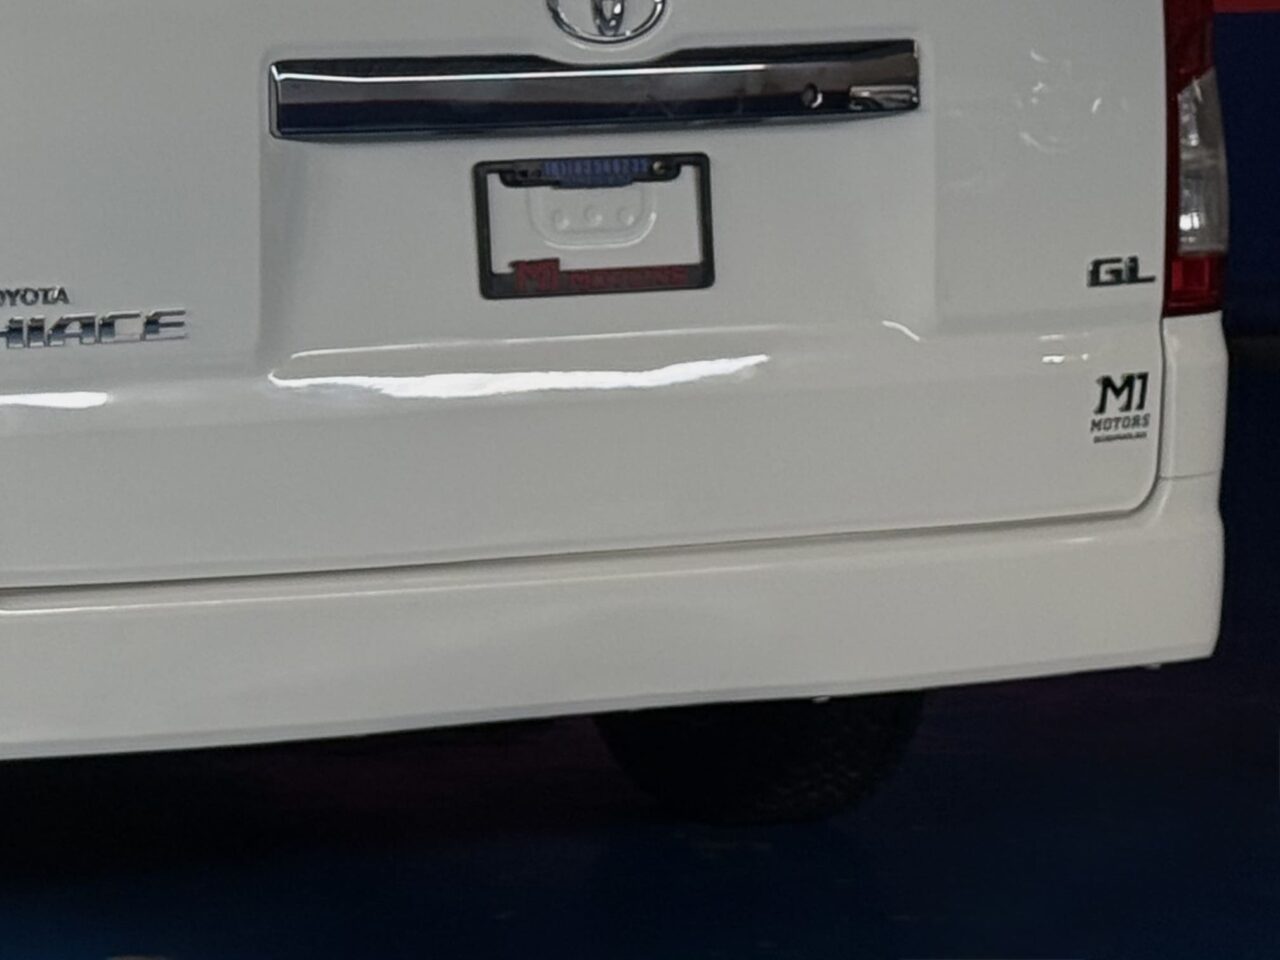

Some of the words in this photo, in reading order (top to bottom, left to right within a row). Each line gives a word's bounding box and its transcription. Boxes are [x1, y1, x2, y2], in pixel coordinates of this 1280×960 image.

[1088, 255, 1156, 287] GL
[1093, 372, 1150, 415] M1
[1090, 413, 1151, 432] MOTORS
